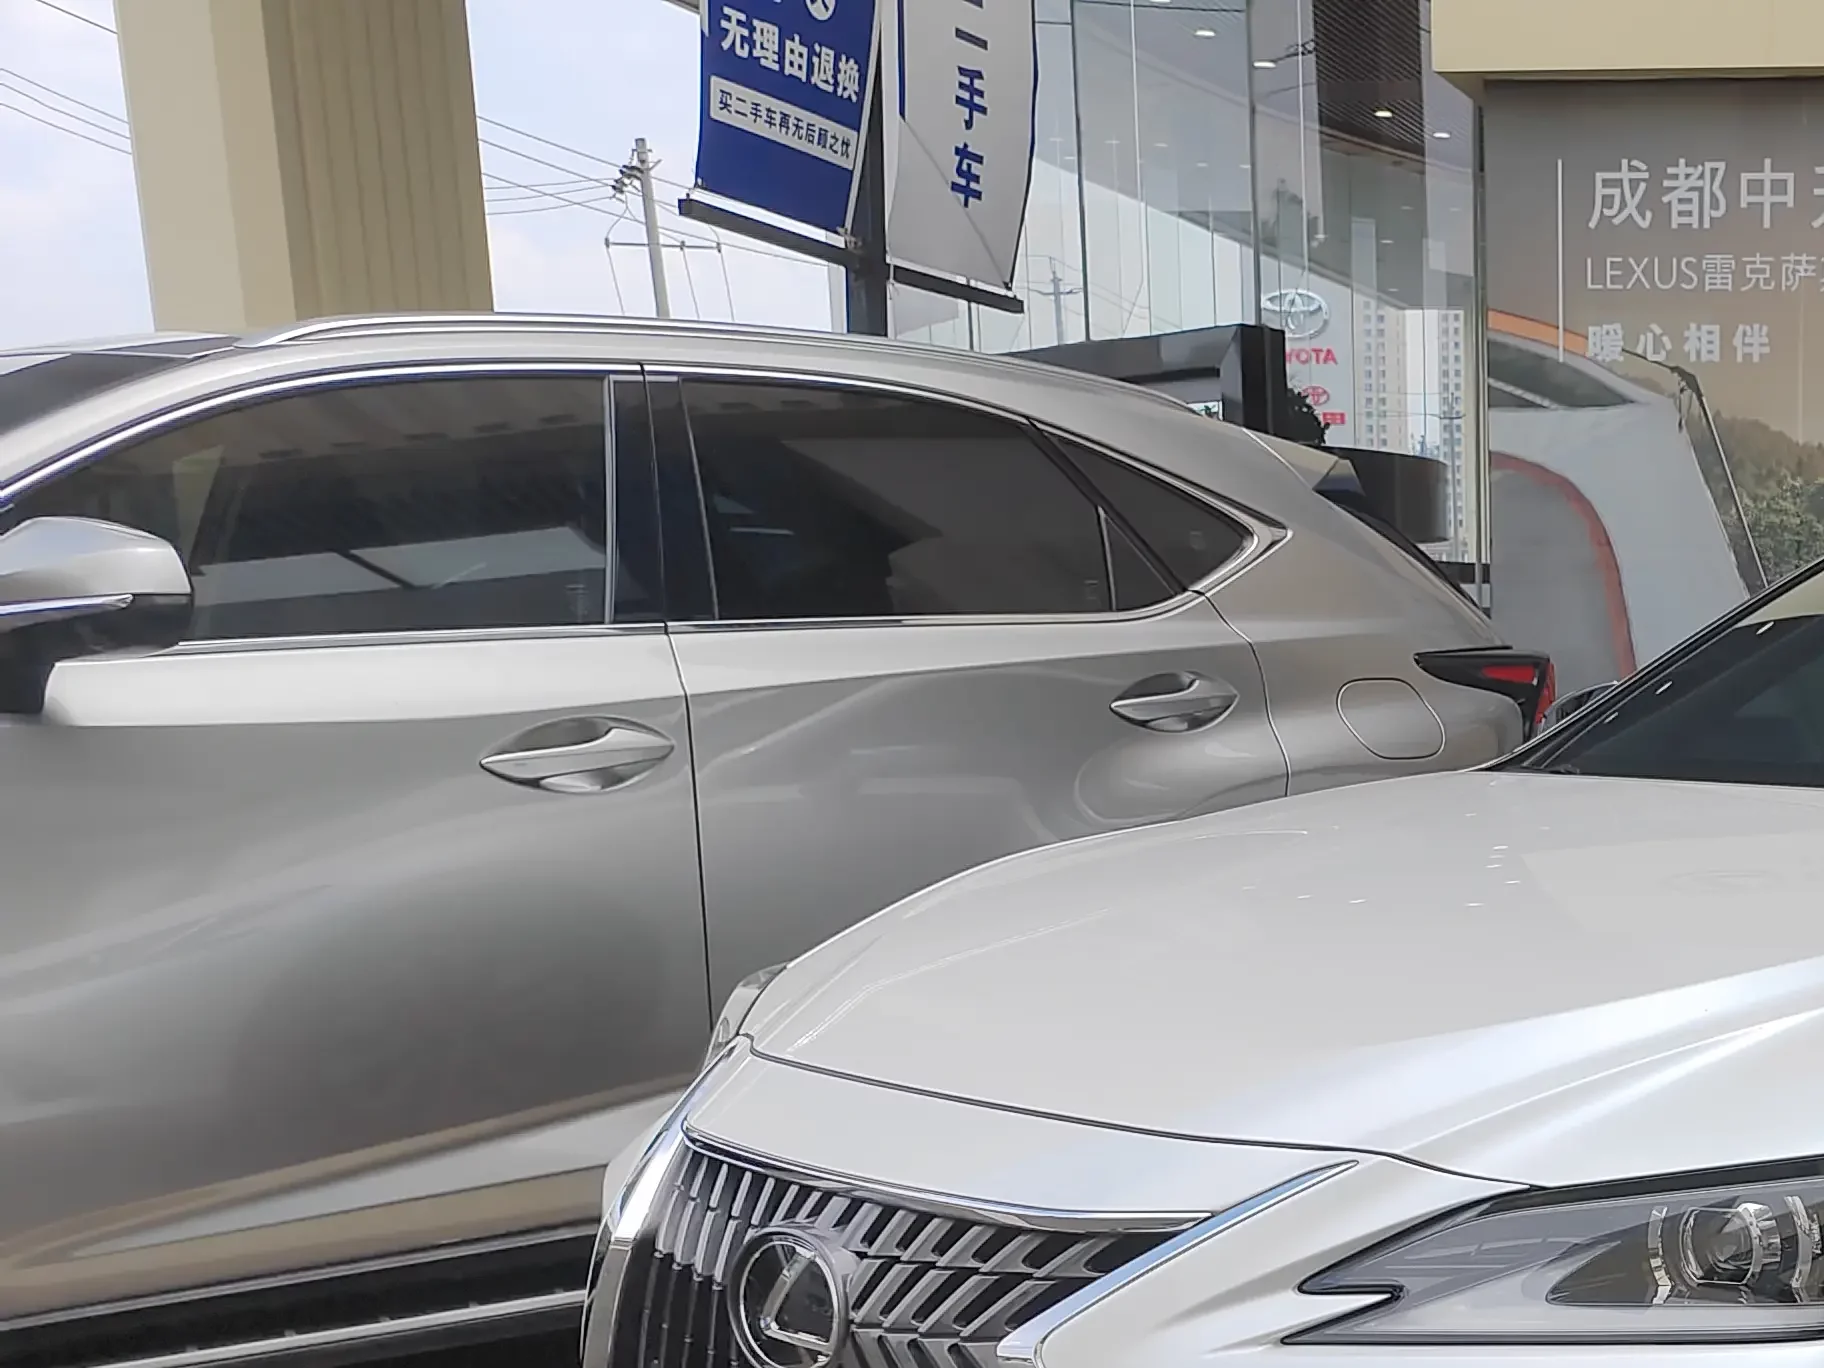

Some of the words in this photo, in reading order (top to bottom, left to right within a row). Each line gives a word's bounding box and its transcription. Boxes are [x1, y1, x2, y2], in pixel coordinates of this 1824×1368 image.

[720, 5, 860, 103] 无理由退换
[718, 89, 852, 159] 买二手车再无后顾之忧
[951, 0, 989, 209] 二手车
[1285, 347, 1338, 366] YOTA
[1587, 322, 1771, 363] 暖心相伴
